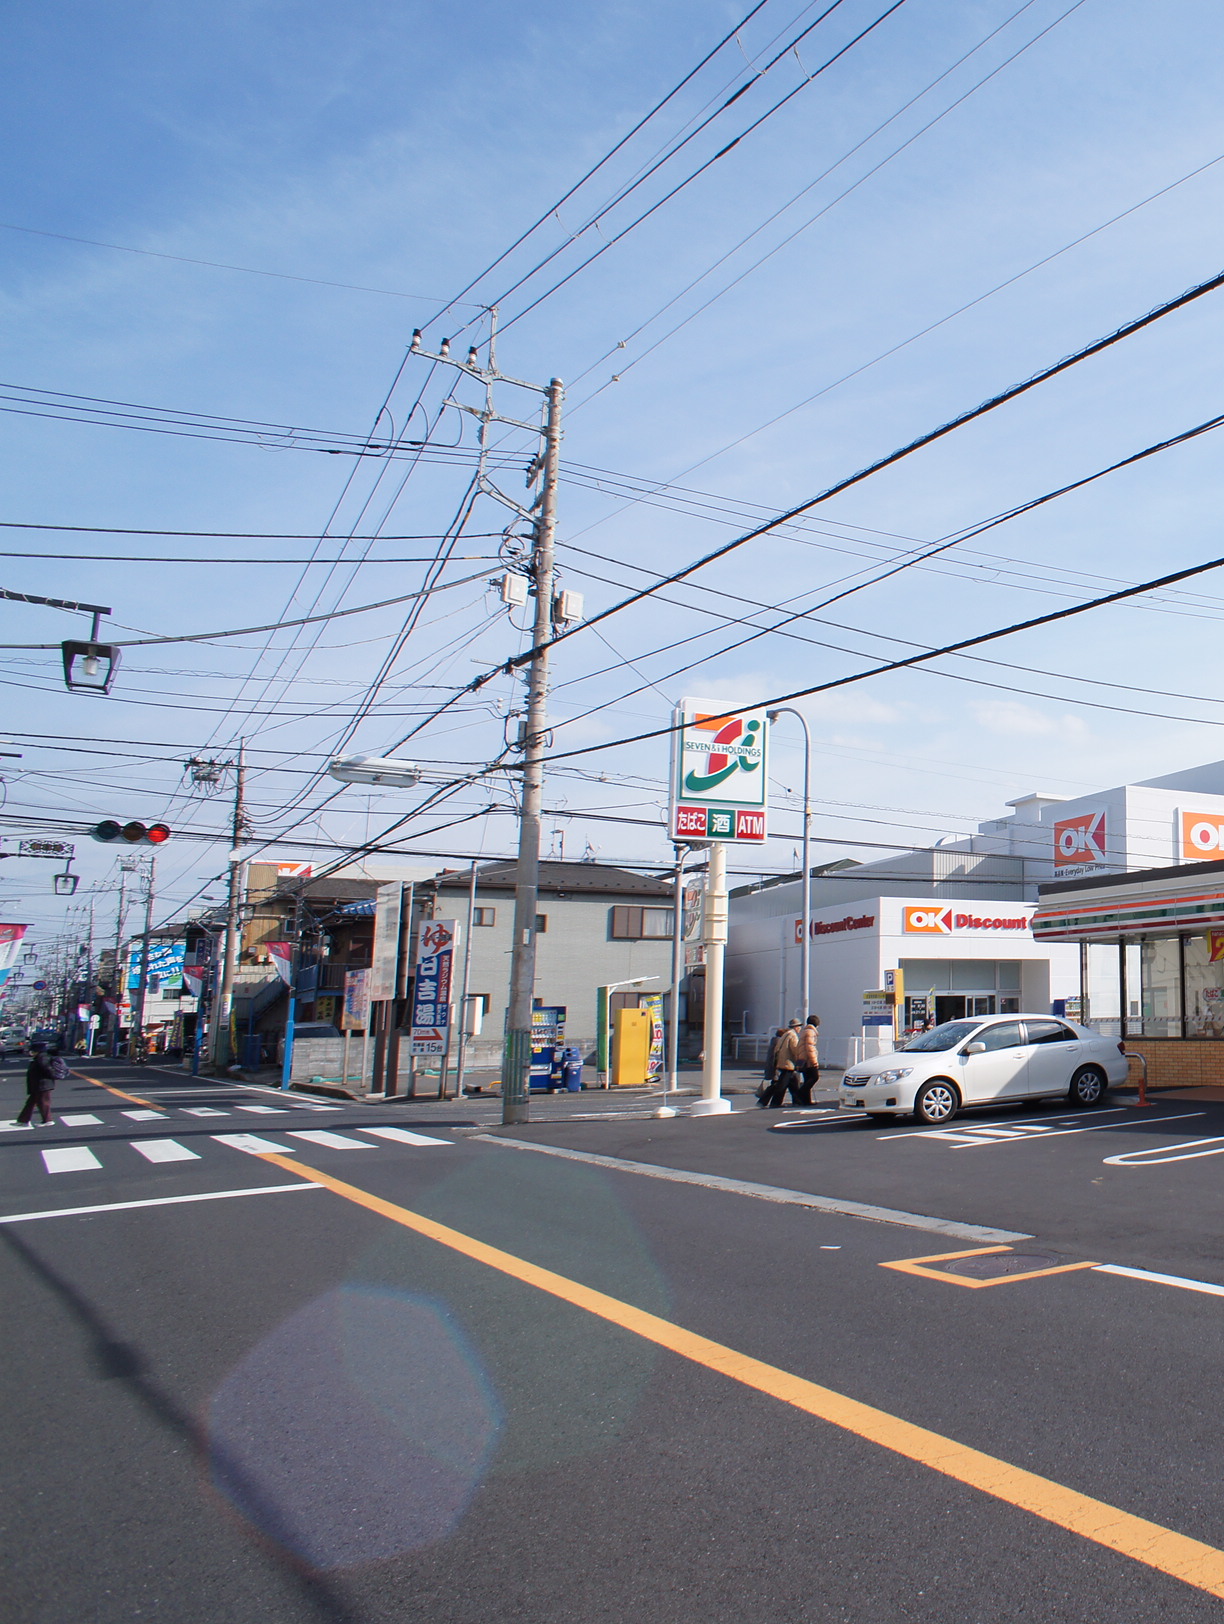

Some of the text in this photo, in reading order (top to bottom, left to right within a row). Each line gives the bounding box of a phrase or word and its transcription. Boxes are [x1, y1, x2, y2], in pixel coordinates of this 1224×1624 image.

[722, 745, 761, 757] HOLDINGS
[677, 811, 764, 835] たばこ 酒 ATM
[1059, 811, 1106, 858] OK
[909, 907, 952, 933] OK
[956, 913, 1027, 930] Discount
[415, 955, 438, 1026] 日吉湯
